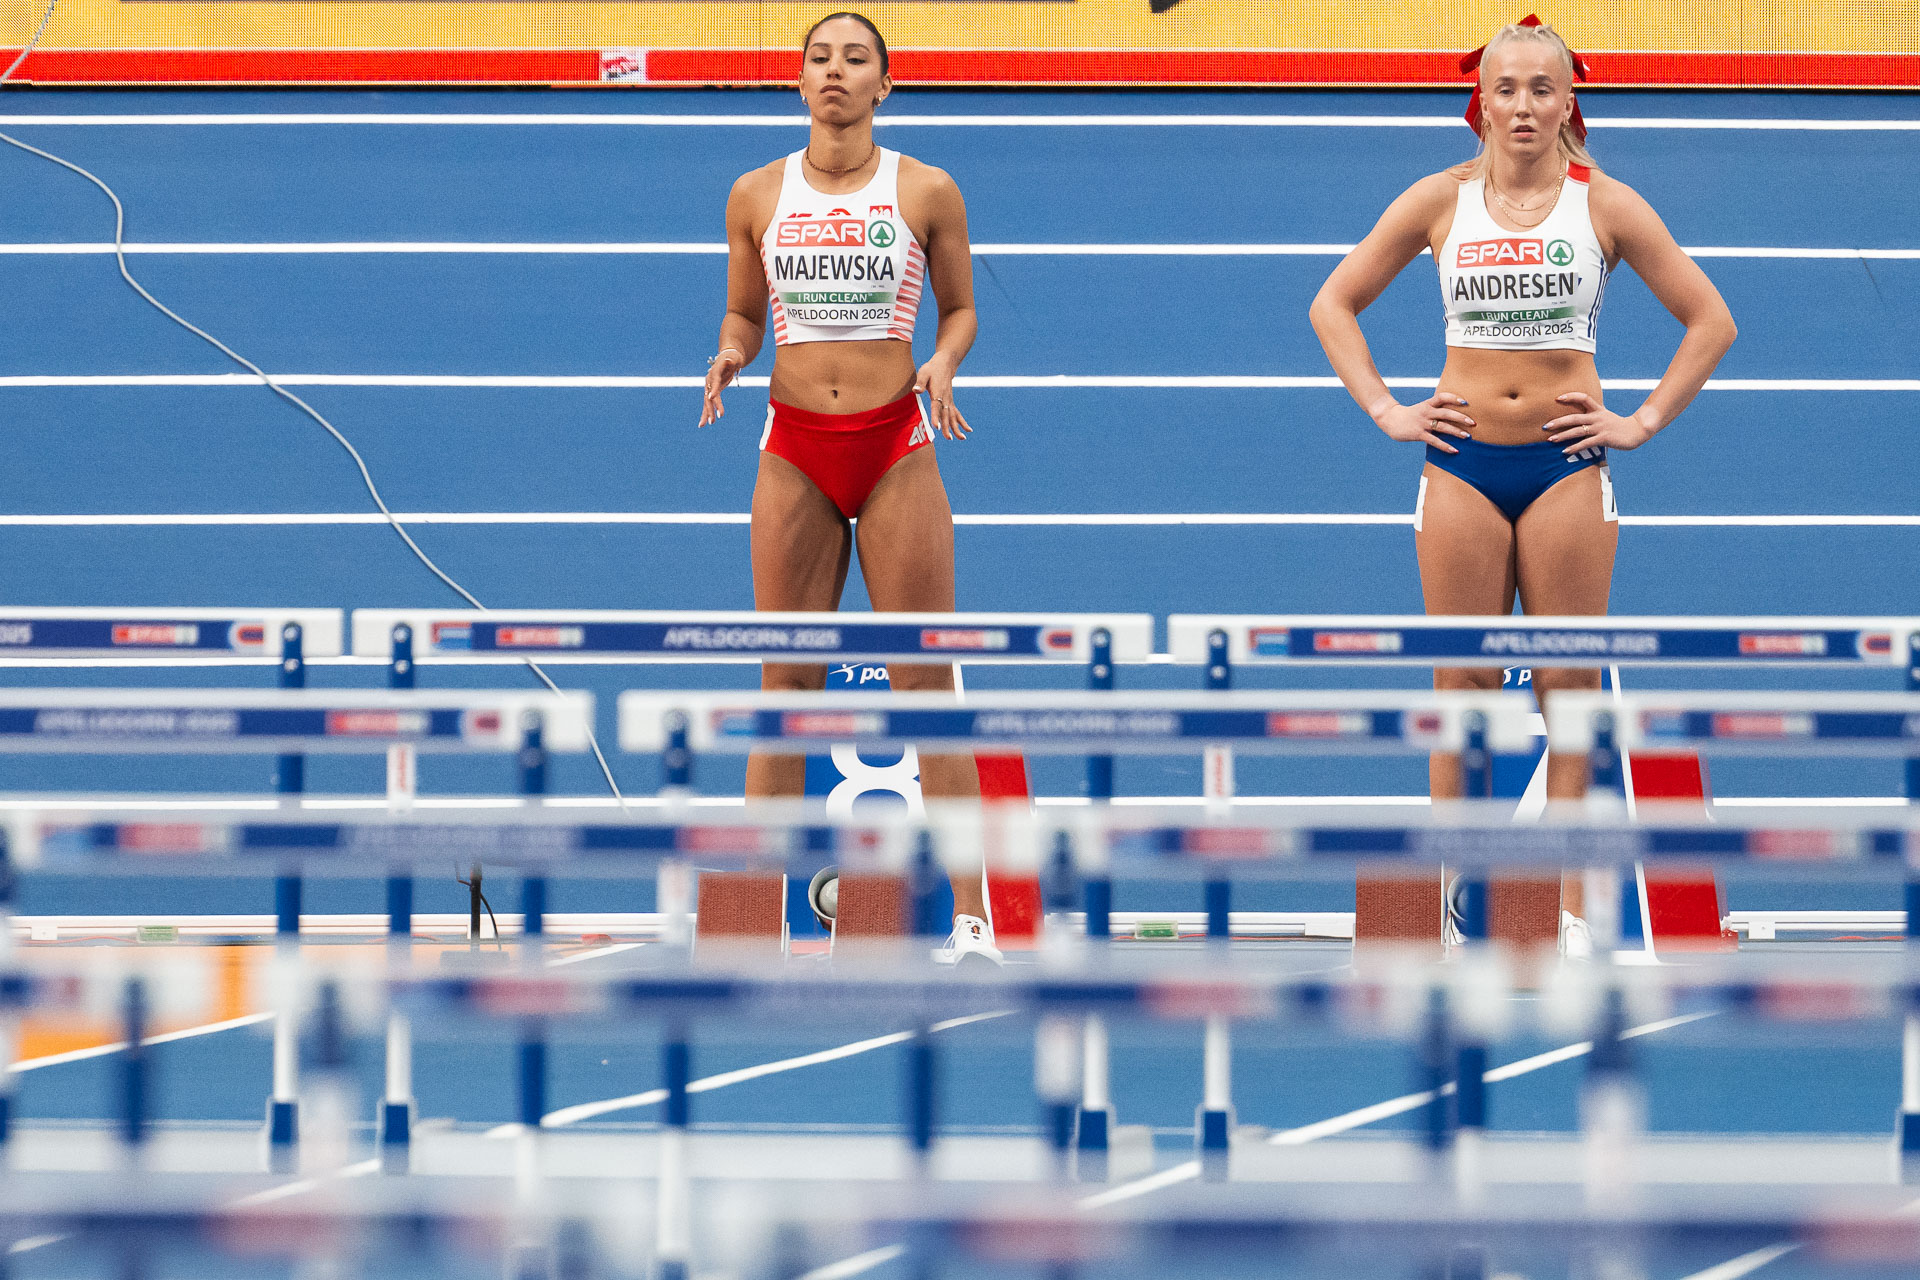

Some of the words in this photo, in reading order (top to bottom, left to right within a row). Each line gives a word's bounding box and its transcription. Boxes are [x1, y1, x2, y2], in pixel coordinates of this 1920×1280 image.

[778, 222, 864, 244] SPAR
[1458, 241, 1542, 265] SPAR
[774, 255, 895, 281] MAJEWSKA
[1454, 272, 1574, 301] ANDRESEN
[803, 293, 828, 303] RUN
[829, 293, 868, 303] CLEAN
[787, 308, 859, 320] APELDOORN
[861, 308, 891, 320] 2025
[1486, 311, 1509, 321] RUN
[1511, 309, 1549, 321] CLEAN
[1463, 325, 1542, 337] APELDOORN
[1544, 321, 1574, 335] 2025
